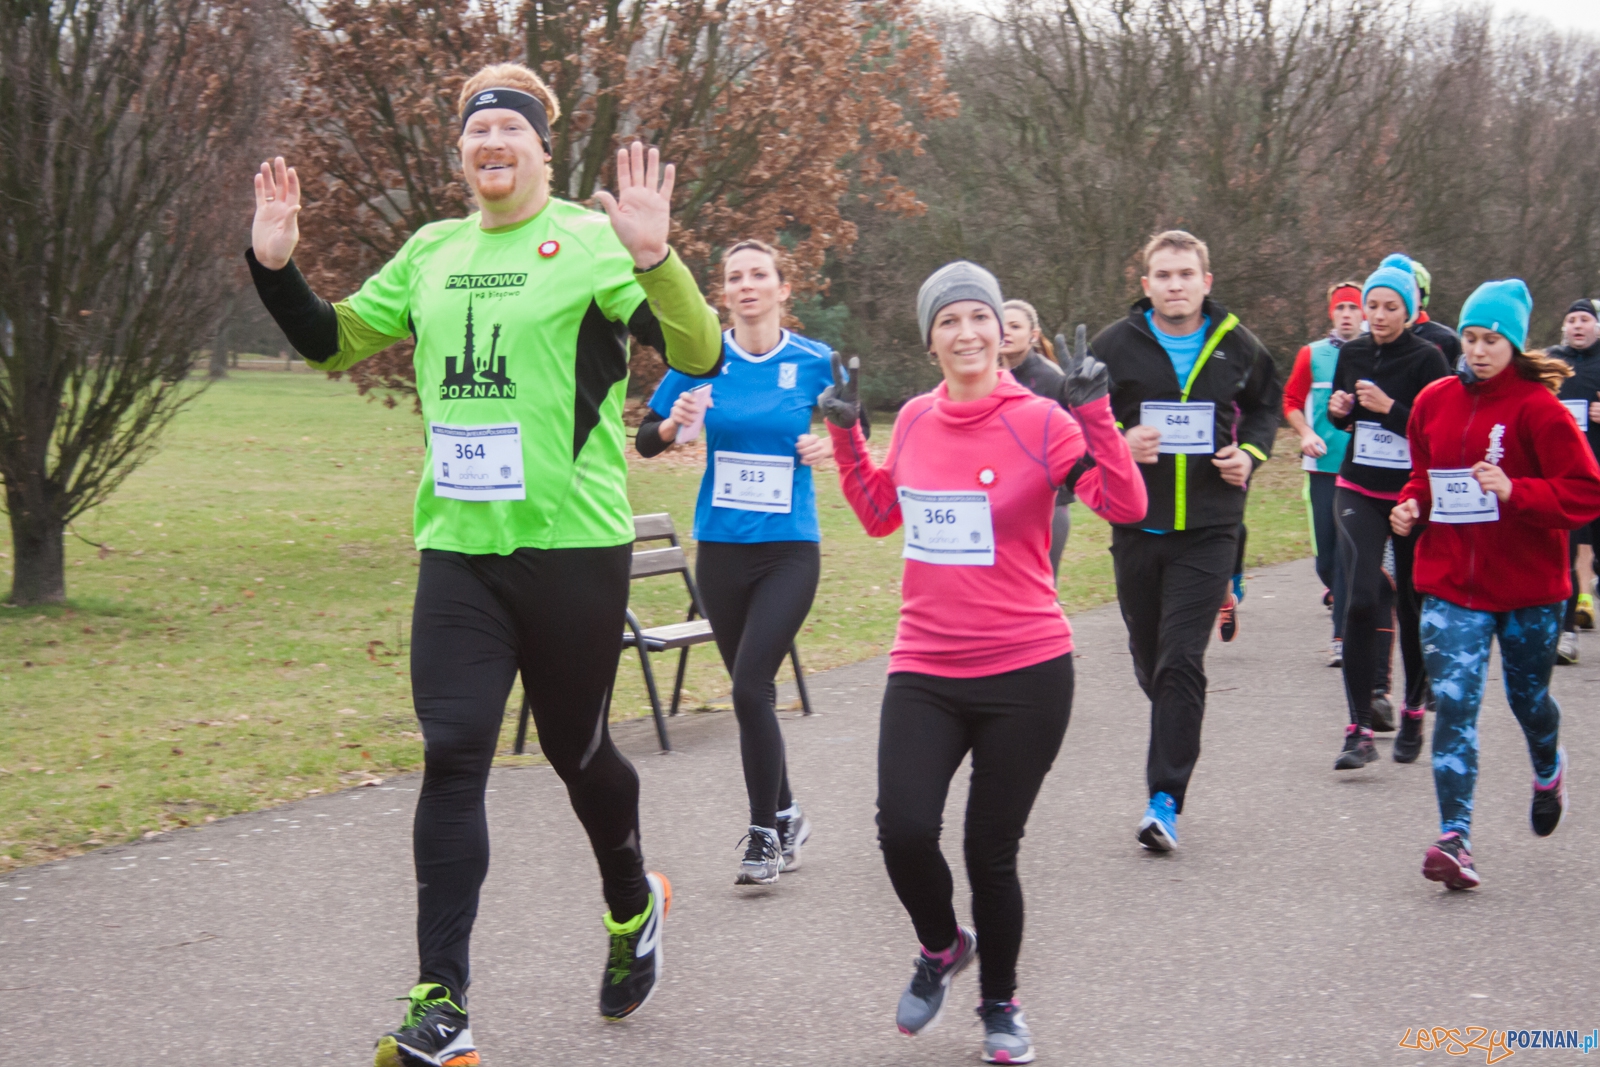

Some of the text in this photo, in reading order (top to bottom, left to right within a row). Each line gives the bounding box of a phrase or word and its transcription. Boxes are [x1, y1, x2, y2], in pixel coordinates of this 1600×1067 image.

[475, 290, 521, 301] na biegowo
[440, 383, 515, 399] POZNAŃ
[1166, 414, 1190, 426] 644
[1373, 433, 1393, 444] 400
[455, 443, 486, 460] 364
[739, 469, 766, 483] 813
[1446, 482, 1470, 494] 402
[924, 508, 956, 525] 366
